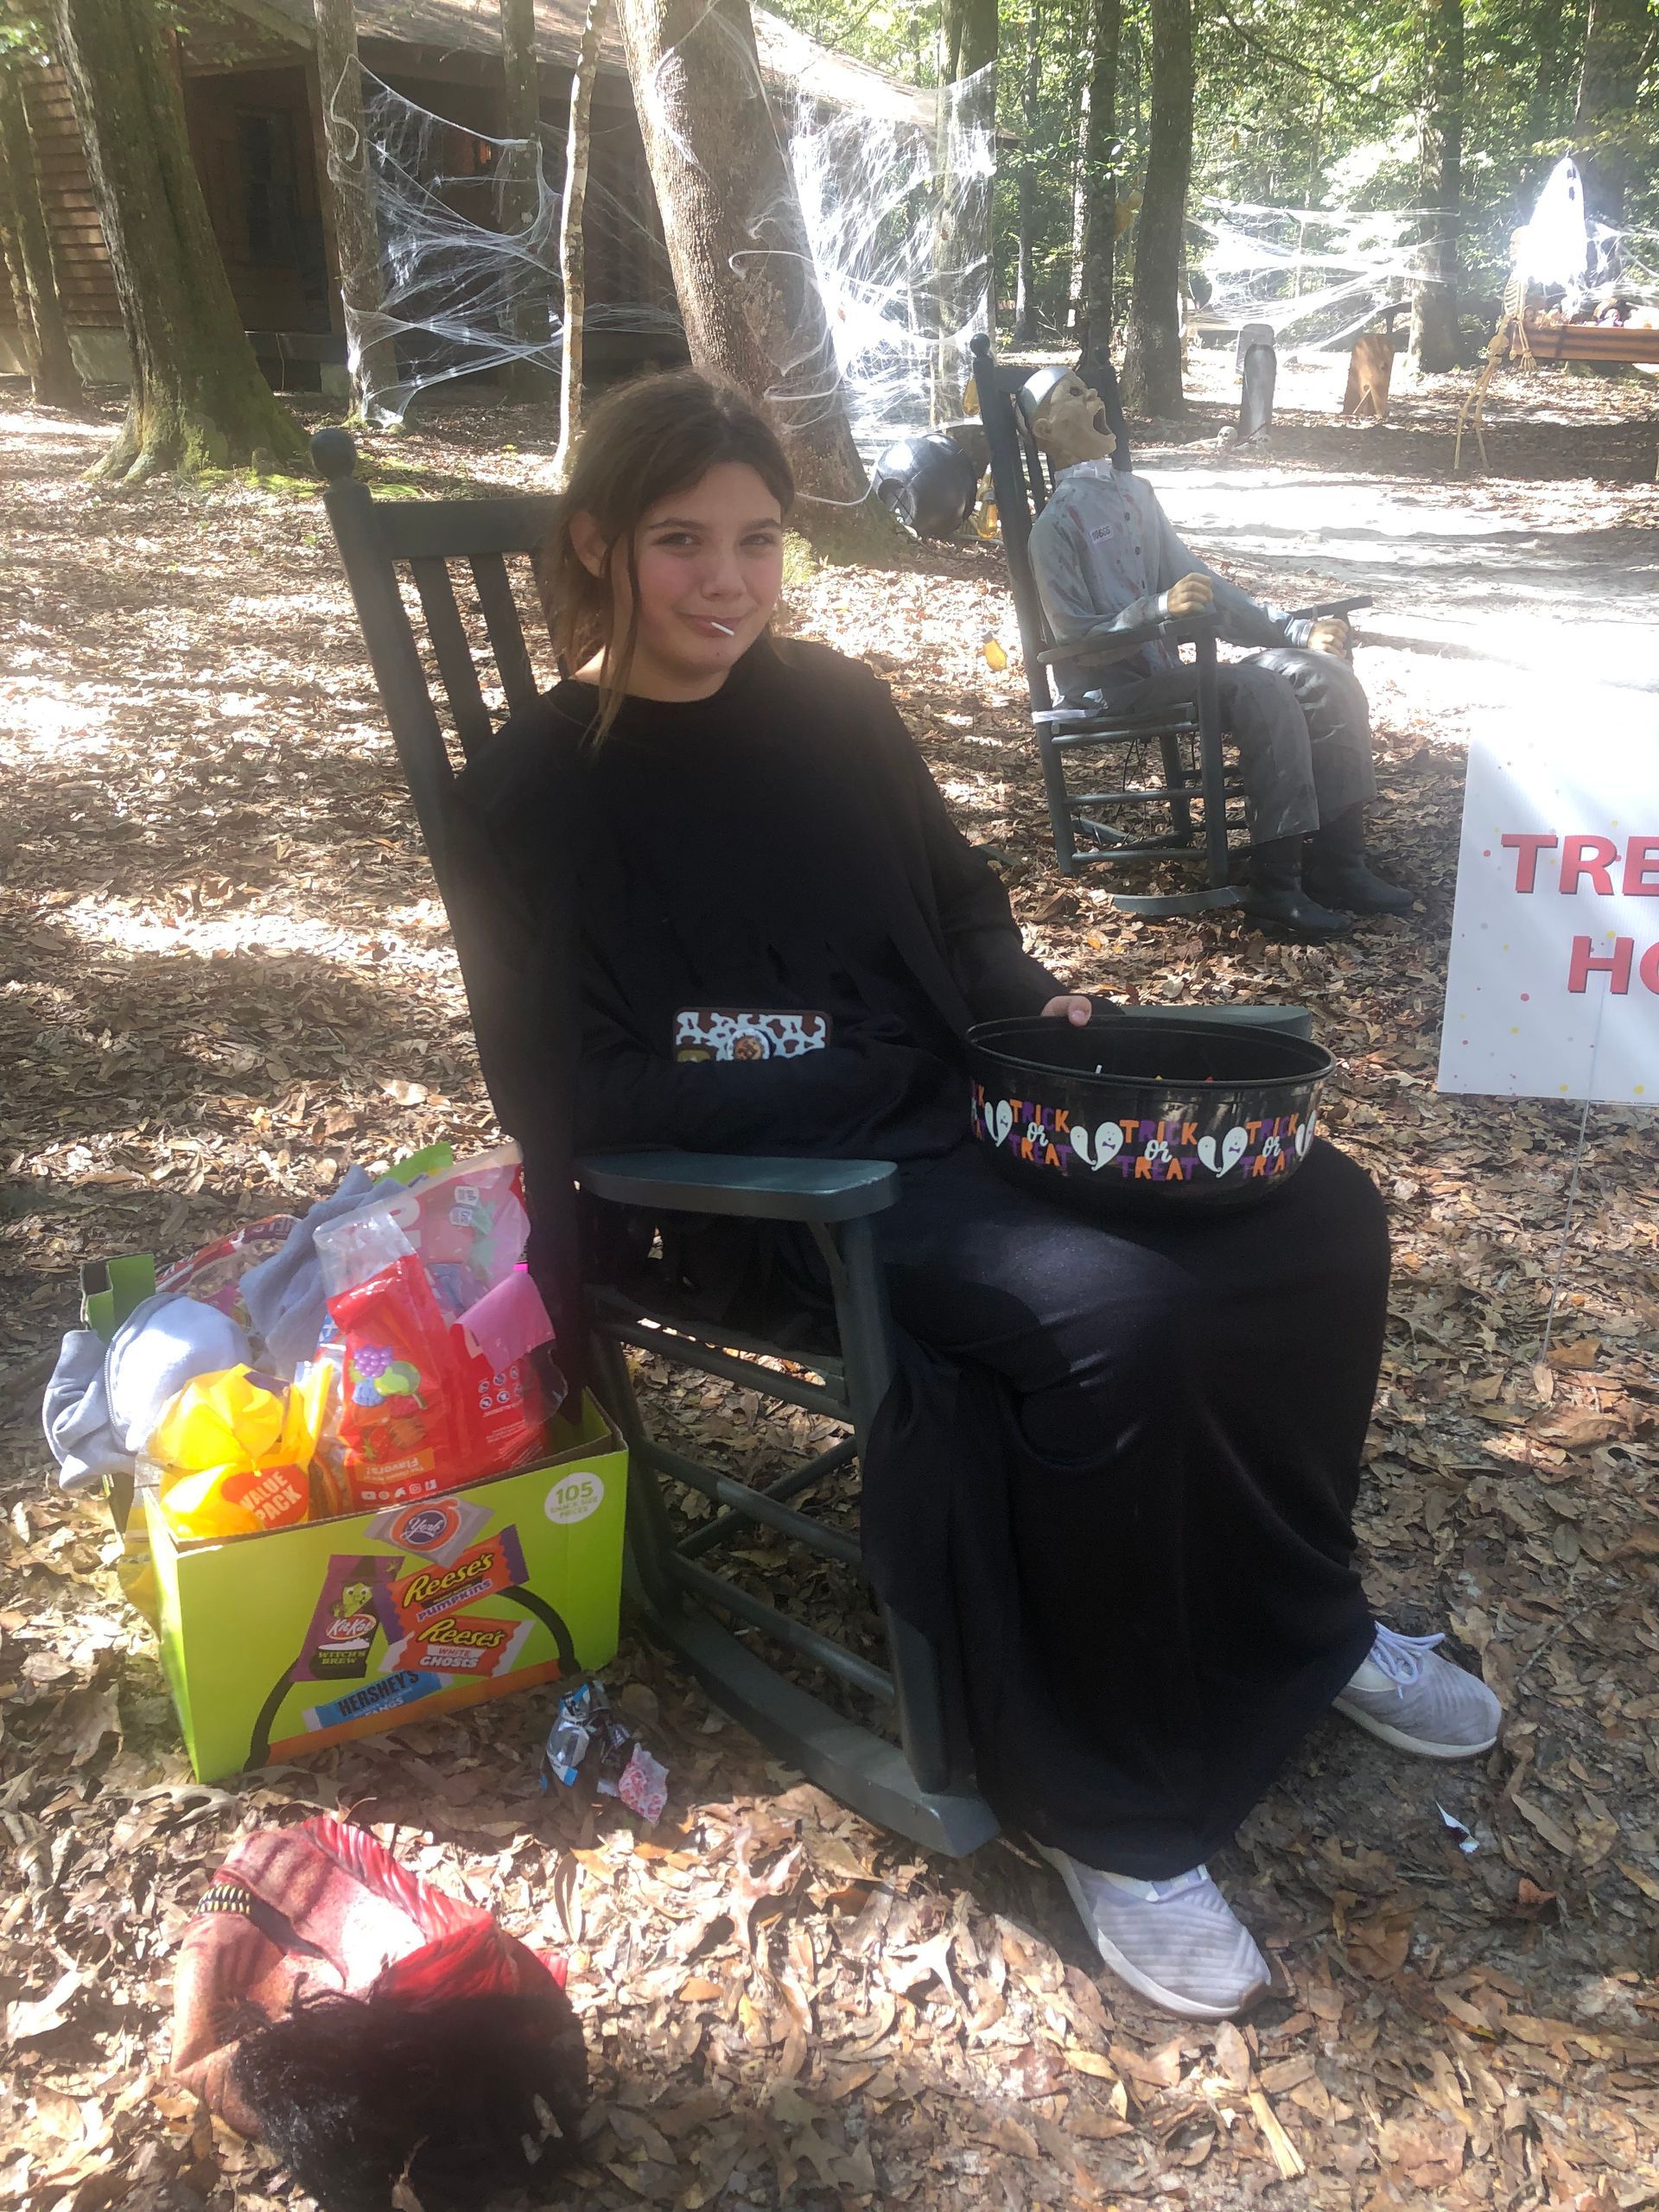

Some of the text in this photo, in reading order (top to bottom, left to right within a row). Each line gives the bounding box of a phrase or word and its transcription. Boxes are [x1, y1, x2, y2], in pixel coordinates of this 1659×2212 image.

[1009, 1098, 1070, 1134] TRICK
[1245, 1112, 1300, 1145] TRICK
[1027, 1122, 1049, 1147] or
[1119, 1120, 1198, 1145] TRICK
[1262, 1135, 1281, 1157] or
[1008, 1134, 1072, 1168] TREAT
[1144, 1140, 1173, 1163] or
[1239, 1147, 1295, 1179] TREAT
[1116, 1155, 1200, 1181] TREAT
[239, 1471, 288, 1511] VALUE
[255, 1484, 302, 1521] PACK
[556, 1481, 594, 1504] 105
[401, 1517, 443, 1540] York
[403, 1554, 493, 1608] Reese's
[418, 1619, 505, 1647] Reese's
[438, 1648, 471, 1657] WHITE
[338, 1670, 419, 1717] HERSHEY'S
